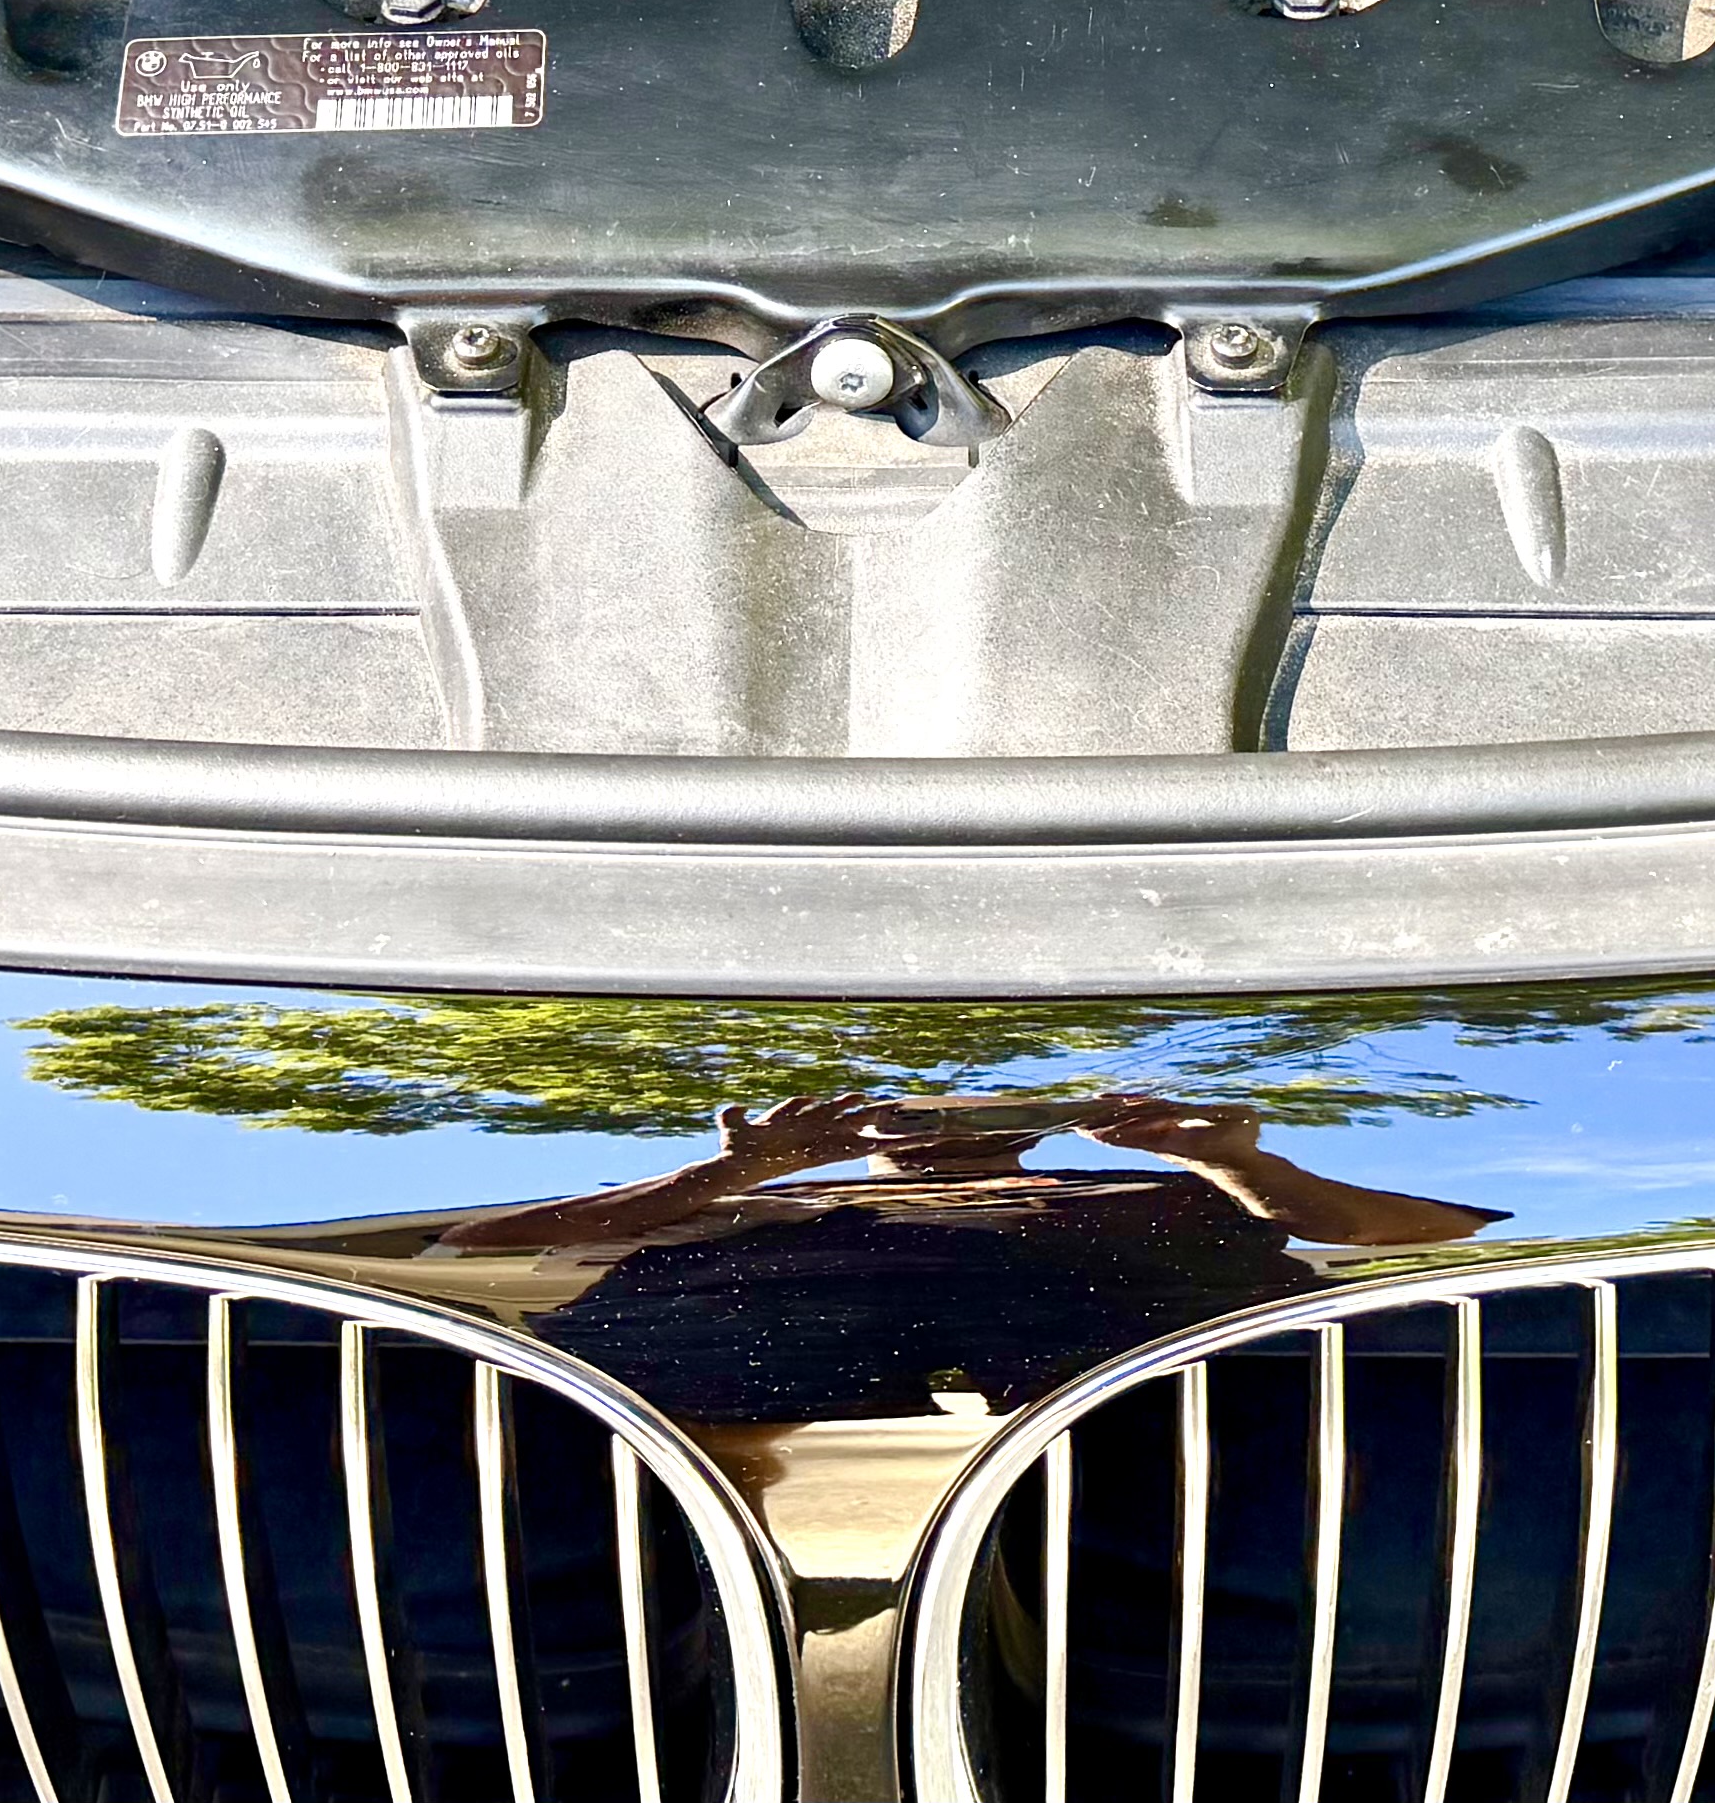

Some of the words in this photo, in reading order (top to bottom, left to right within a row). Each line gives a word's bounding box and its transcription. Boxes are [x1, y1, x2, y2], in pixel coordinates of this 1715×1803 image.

[303, 38, 323, 50] For
[330, 40, 360, 50] more
[367, 37, 392, 49] info
[399, 39, 420, 48] see
[426, 35, 472, 48] Owner's
[479, 34, 520, 46] Manual
[302, 51, 322, 63] For
[330, 54, 338, 62] a
[344, 49, 366, 62] list
[373, 49, 388, 61] of
[394, 48, 426, 60] other
[434, 46, 489, 62] approved
[496, 46, 520, 59] oils
[327, 63, 351, 74] call
[347, 74, 376, 84] visit
[383, 76, 403, 84] our
[410, 73, 433, 83] web
[440, 72, 464, 83] site
[471, 72, 484, 82] at
[180, 80, 207, 93] Use
[216, 80, 250, 94] only
[327, 86, 429, 96] www.bmwusa.com
[136, 94, 164, 107] BMW
[169, 93, 196, 106] HIGH
[202, 91, 282, 105] PERFORMANCE
[162, 106, 224, 119] SYNTHETIC
[230, 105, 250, 118] OIL
[133, 121, 156, 132] Part
[161, 121, 177, 132] No.
